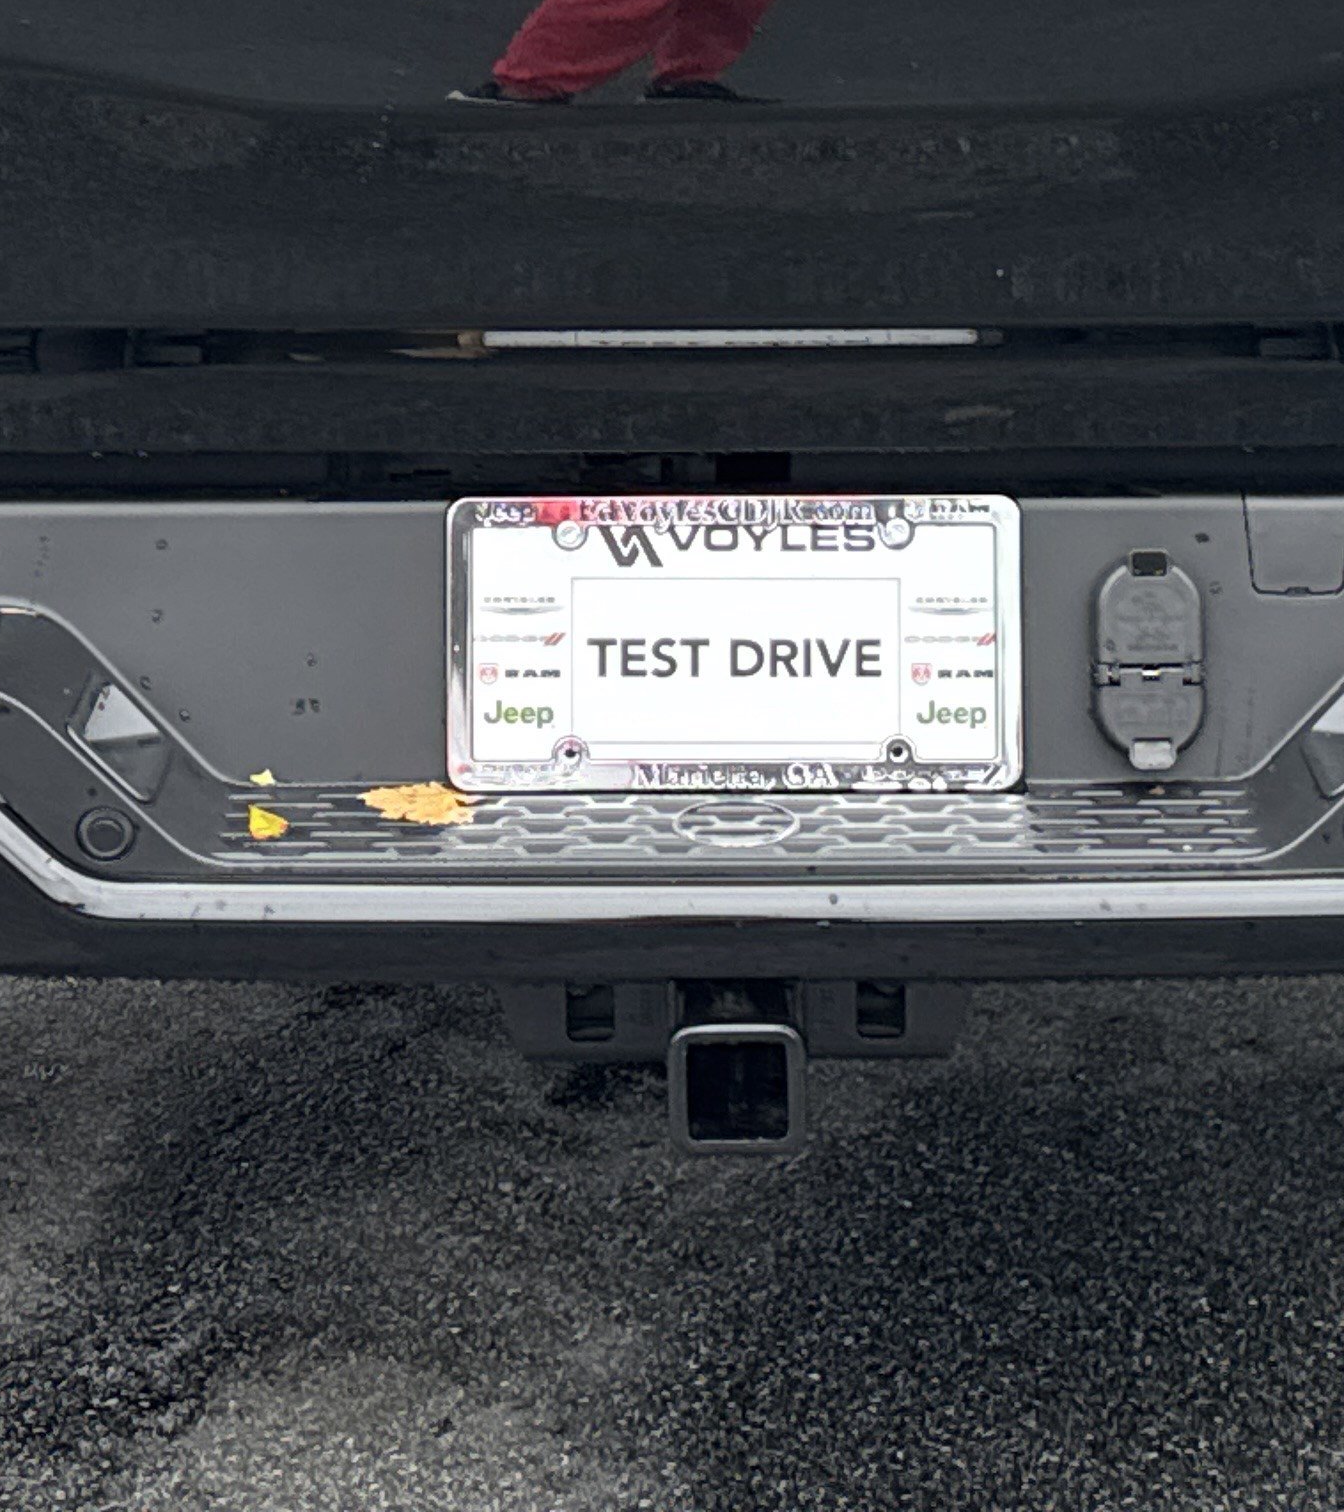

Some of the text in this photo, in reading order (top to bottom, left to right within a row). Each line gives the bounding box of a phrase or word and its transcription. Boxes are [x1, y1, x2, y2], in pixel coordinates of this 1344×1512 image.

[670, 524, 876, 552] VOYLES
[587, 638, 882, 678] TEST DRIVE
[483, 699, 555, 729] Jeep
[916, 699, 987, 729] Jeep
